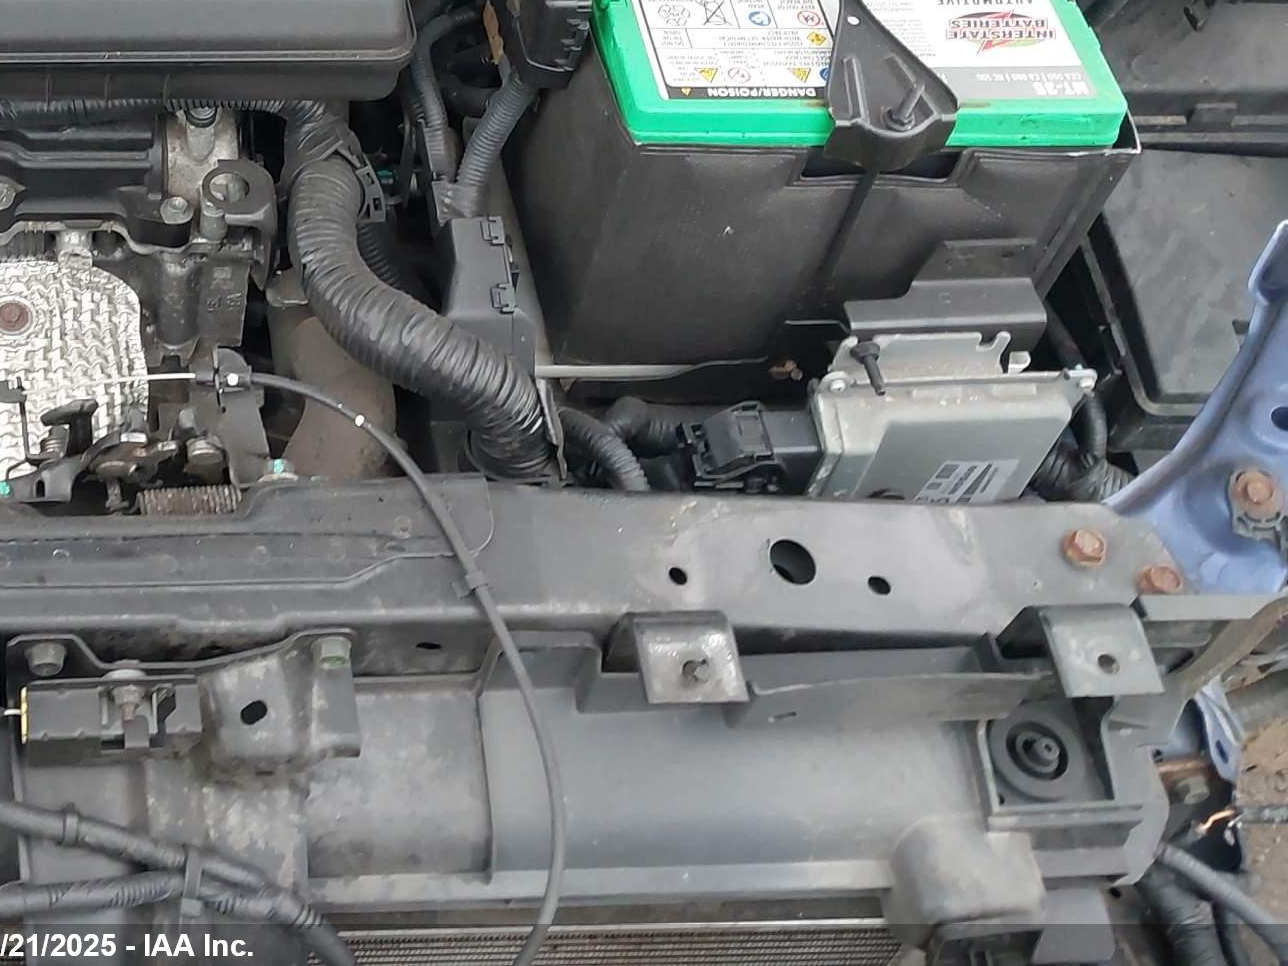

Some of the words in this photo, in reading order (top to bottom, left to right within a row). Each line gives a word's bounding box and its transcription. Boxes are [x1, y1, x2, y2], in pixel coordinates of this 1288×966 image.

[951, 19, 1047, 30] BATTERIES
[947, 29, 1055, 41] INTERSTATE
[707, 87, 817, 98] DANGER/POISON
